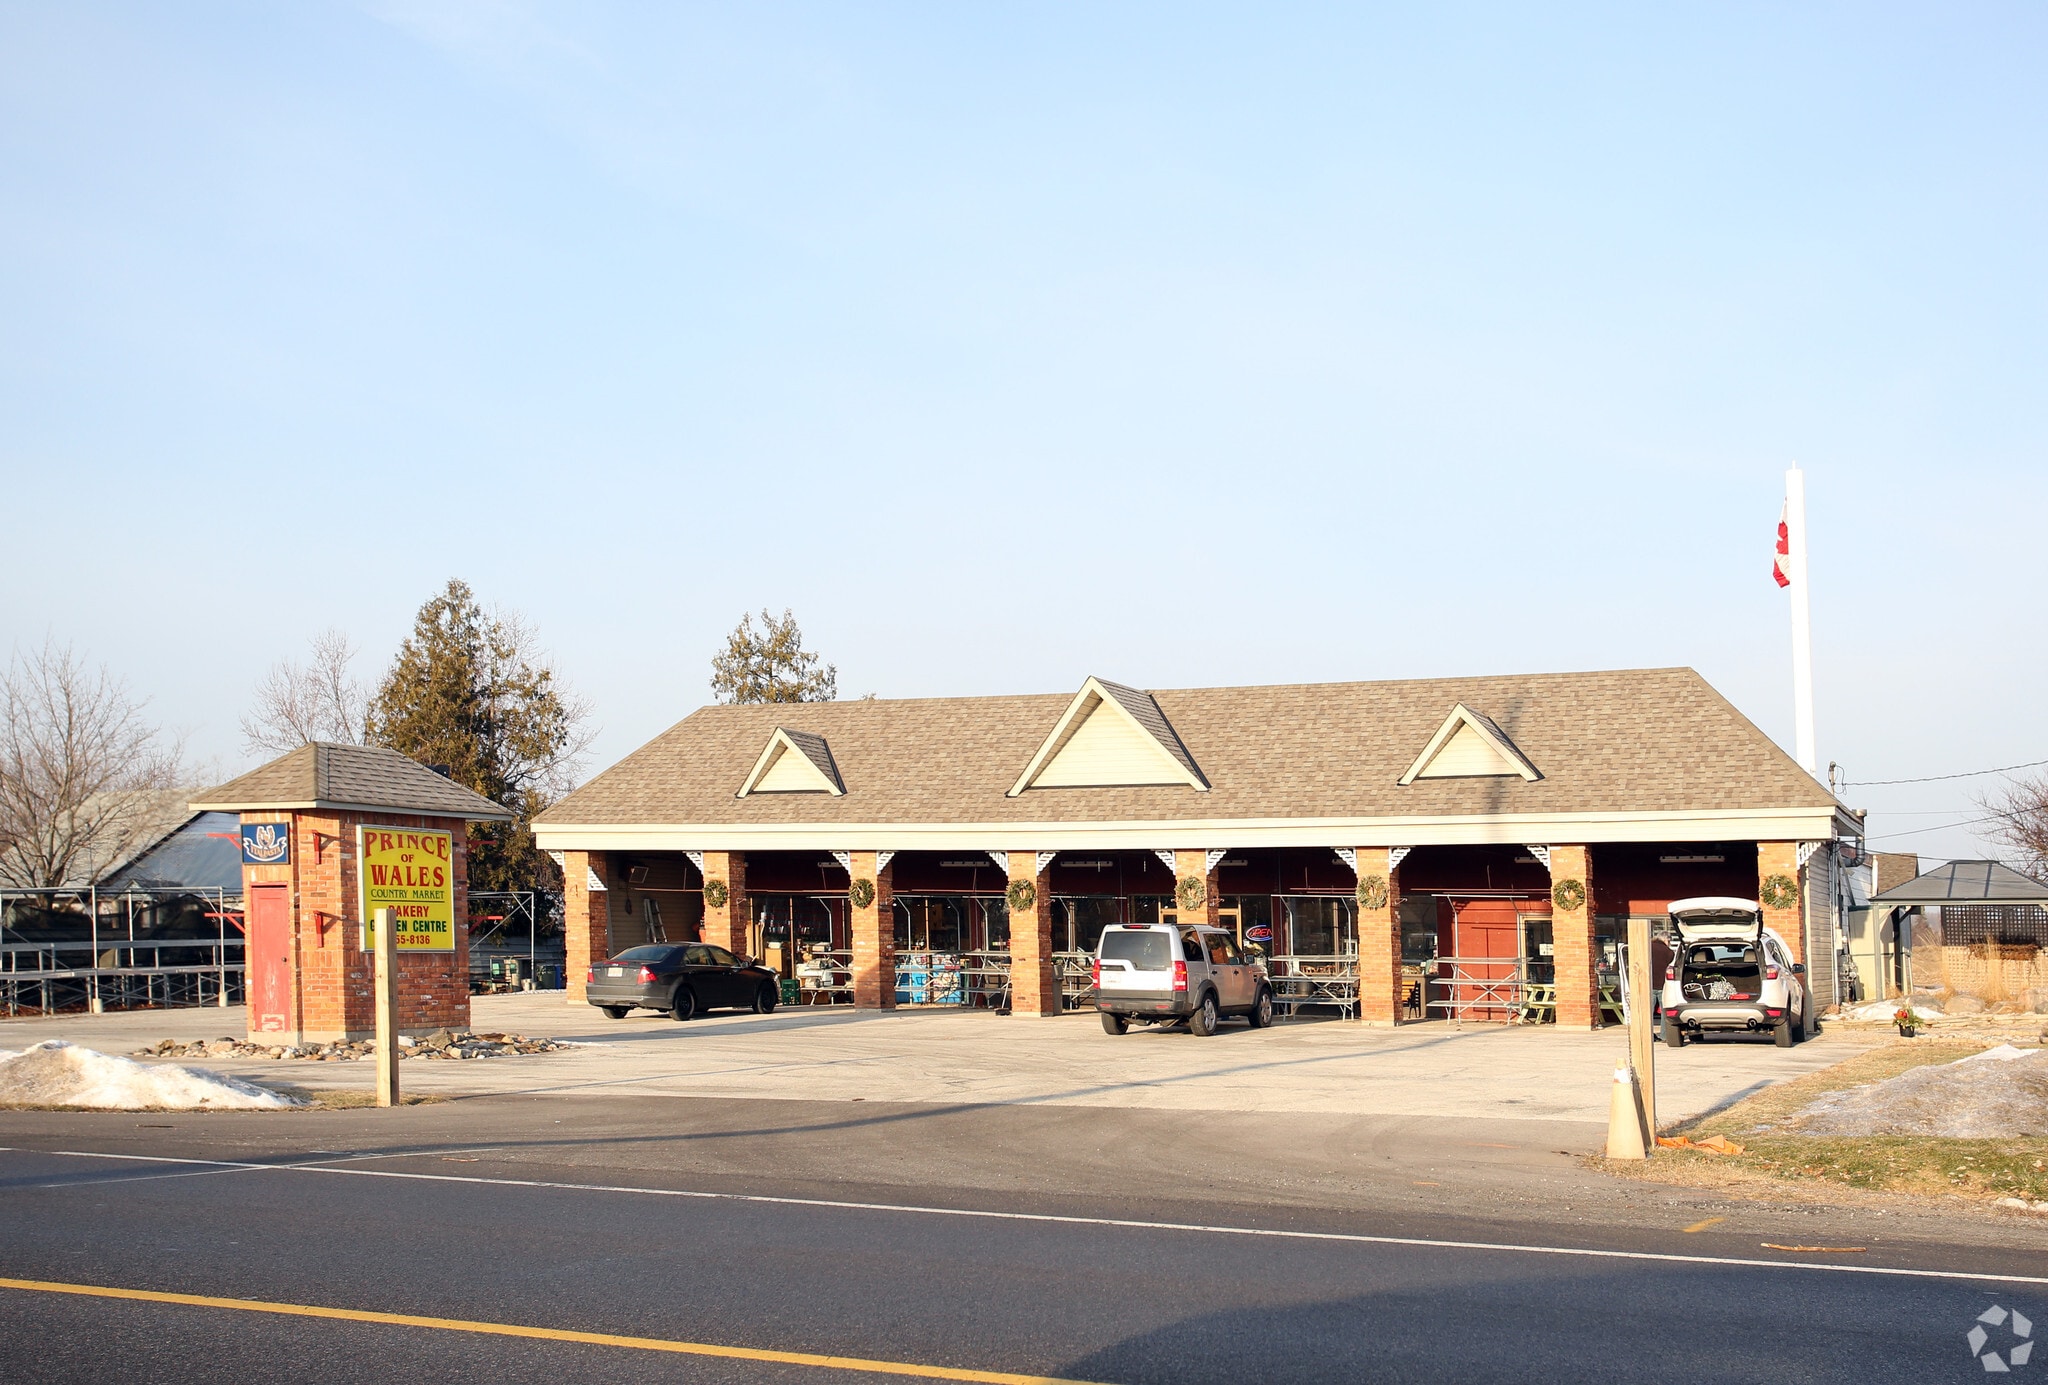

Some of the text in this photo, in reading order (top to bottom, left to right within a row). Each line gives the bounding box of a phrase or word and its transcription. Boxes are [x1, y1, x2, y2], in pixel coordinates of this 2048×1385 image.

[364, 831, 449, 862] PRINCE
[401, 854, 414, 863] OF
[370, 864, 444, 887] WALES
[370, 889, 444, 899] COUNTRY MARKET
[370, 919, 447, 932] GEN CENTRE
